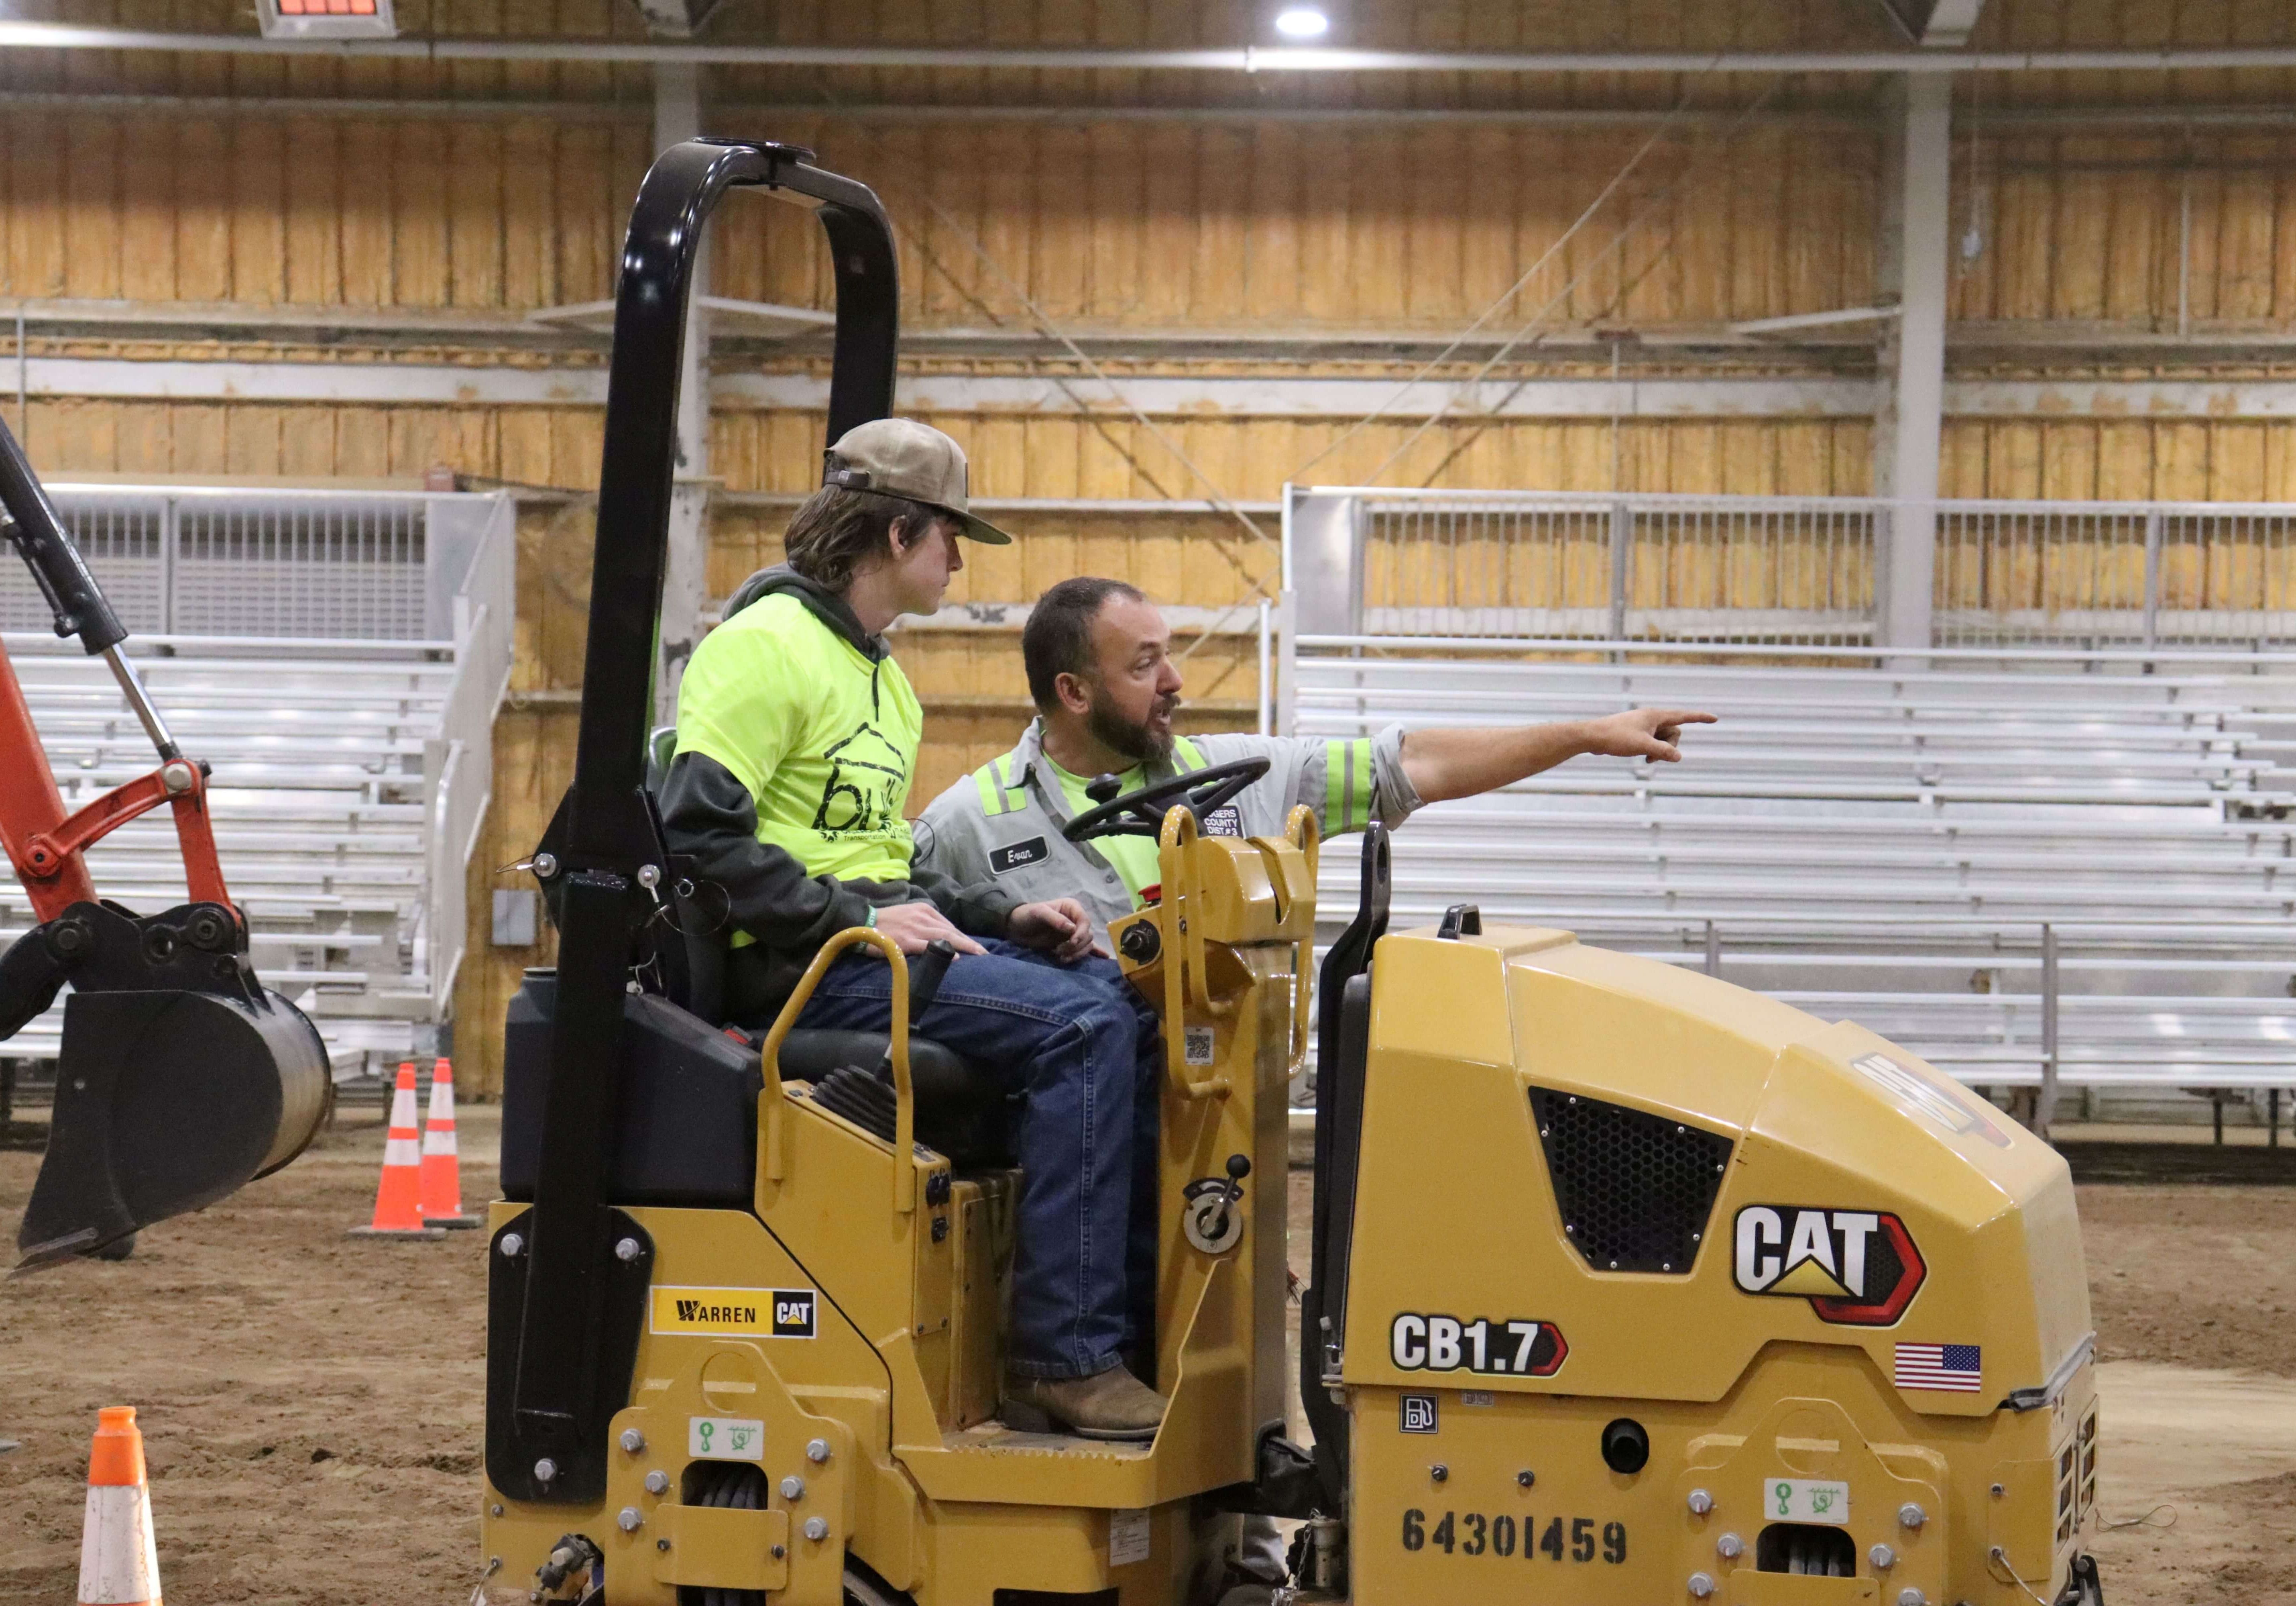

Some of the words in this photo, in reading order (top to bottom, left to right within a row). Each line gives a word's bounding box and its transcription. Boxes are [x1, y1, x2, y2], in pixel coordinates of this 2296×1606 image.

[1204, 818, 1238, 827] COUNTY
[1209, 809, 1236, 818] GERS
[1008, 850, 1032, 863] Evan
[1737, 1207, 1878, 1296] CAT
[676, 1300, 755, 1323] WARREN
[777, 1302, 810, 1325] CAT
[1394, 1316, 1538, 1372] CB1.7
[1410, 1414, 1419, 1424] D
[1402, 1508, 1626, 1564] 64301459
